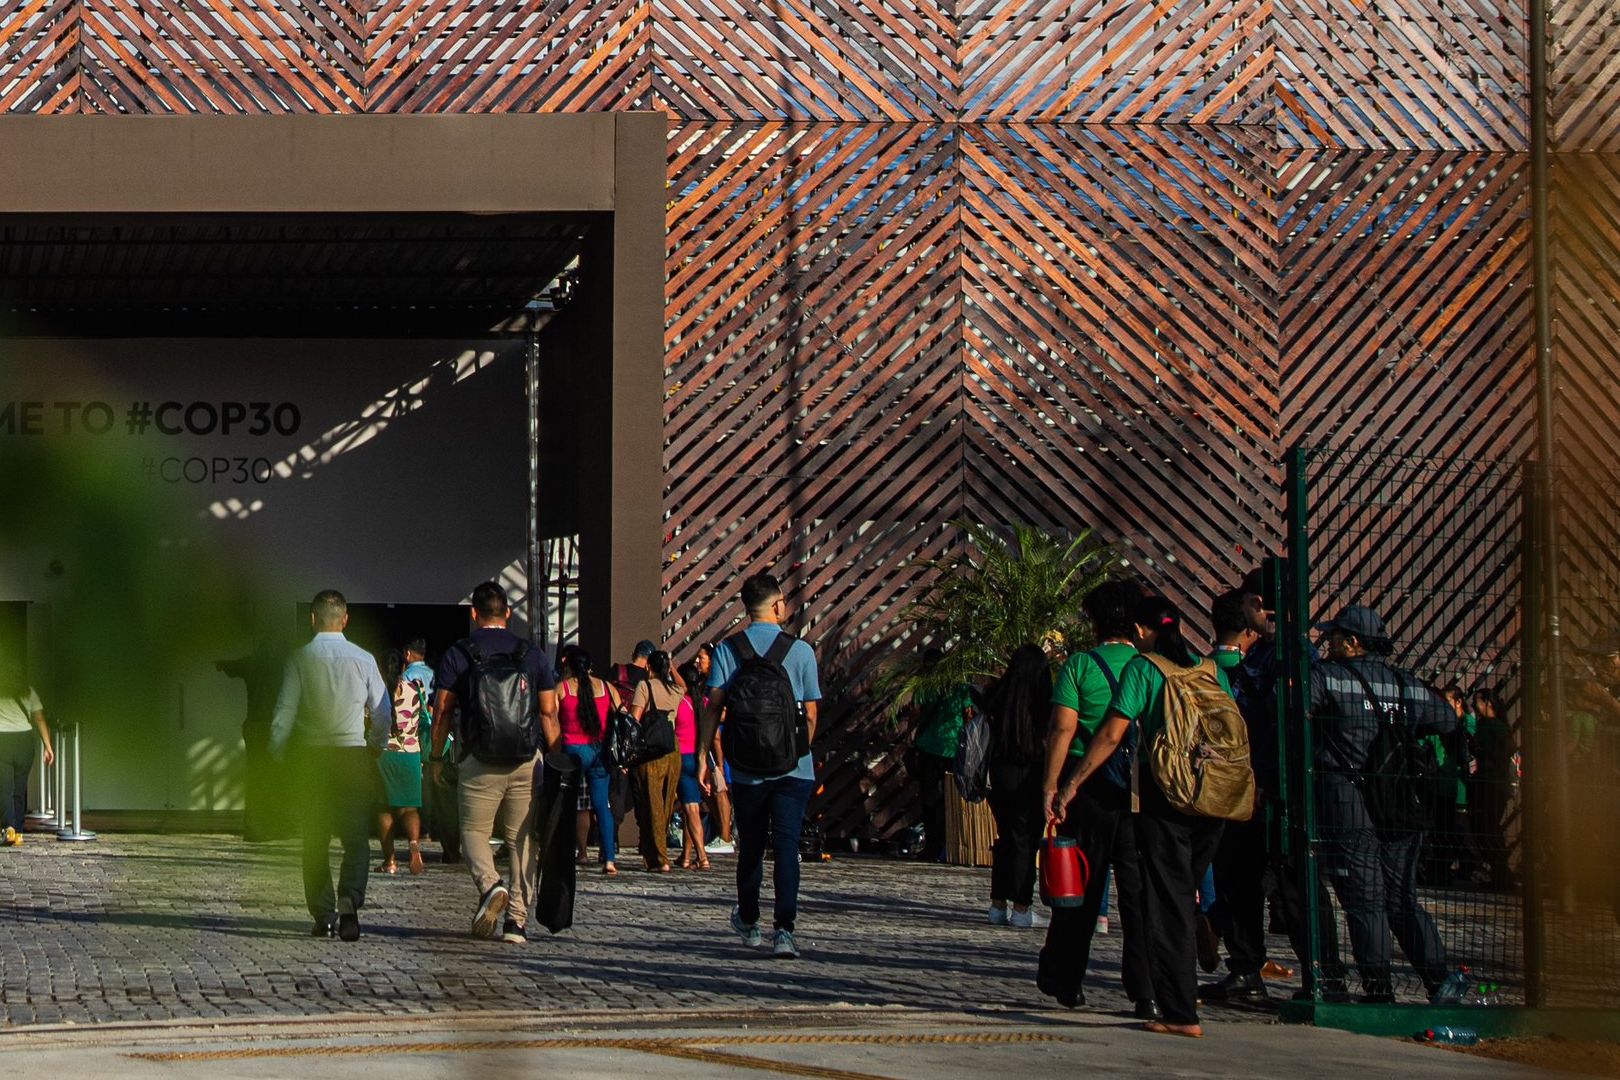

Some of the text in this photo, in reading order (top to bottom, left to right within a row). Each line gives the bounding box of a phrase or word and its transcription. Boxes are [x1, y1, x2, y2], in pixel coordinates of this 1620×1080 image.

[54, 401, 115, 436] TO
[126, 400, 302, 437] #COP30
[140, 456, 273, 485] #COP30
